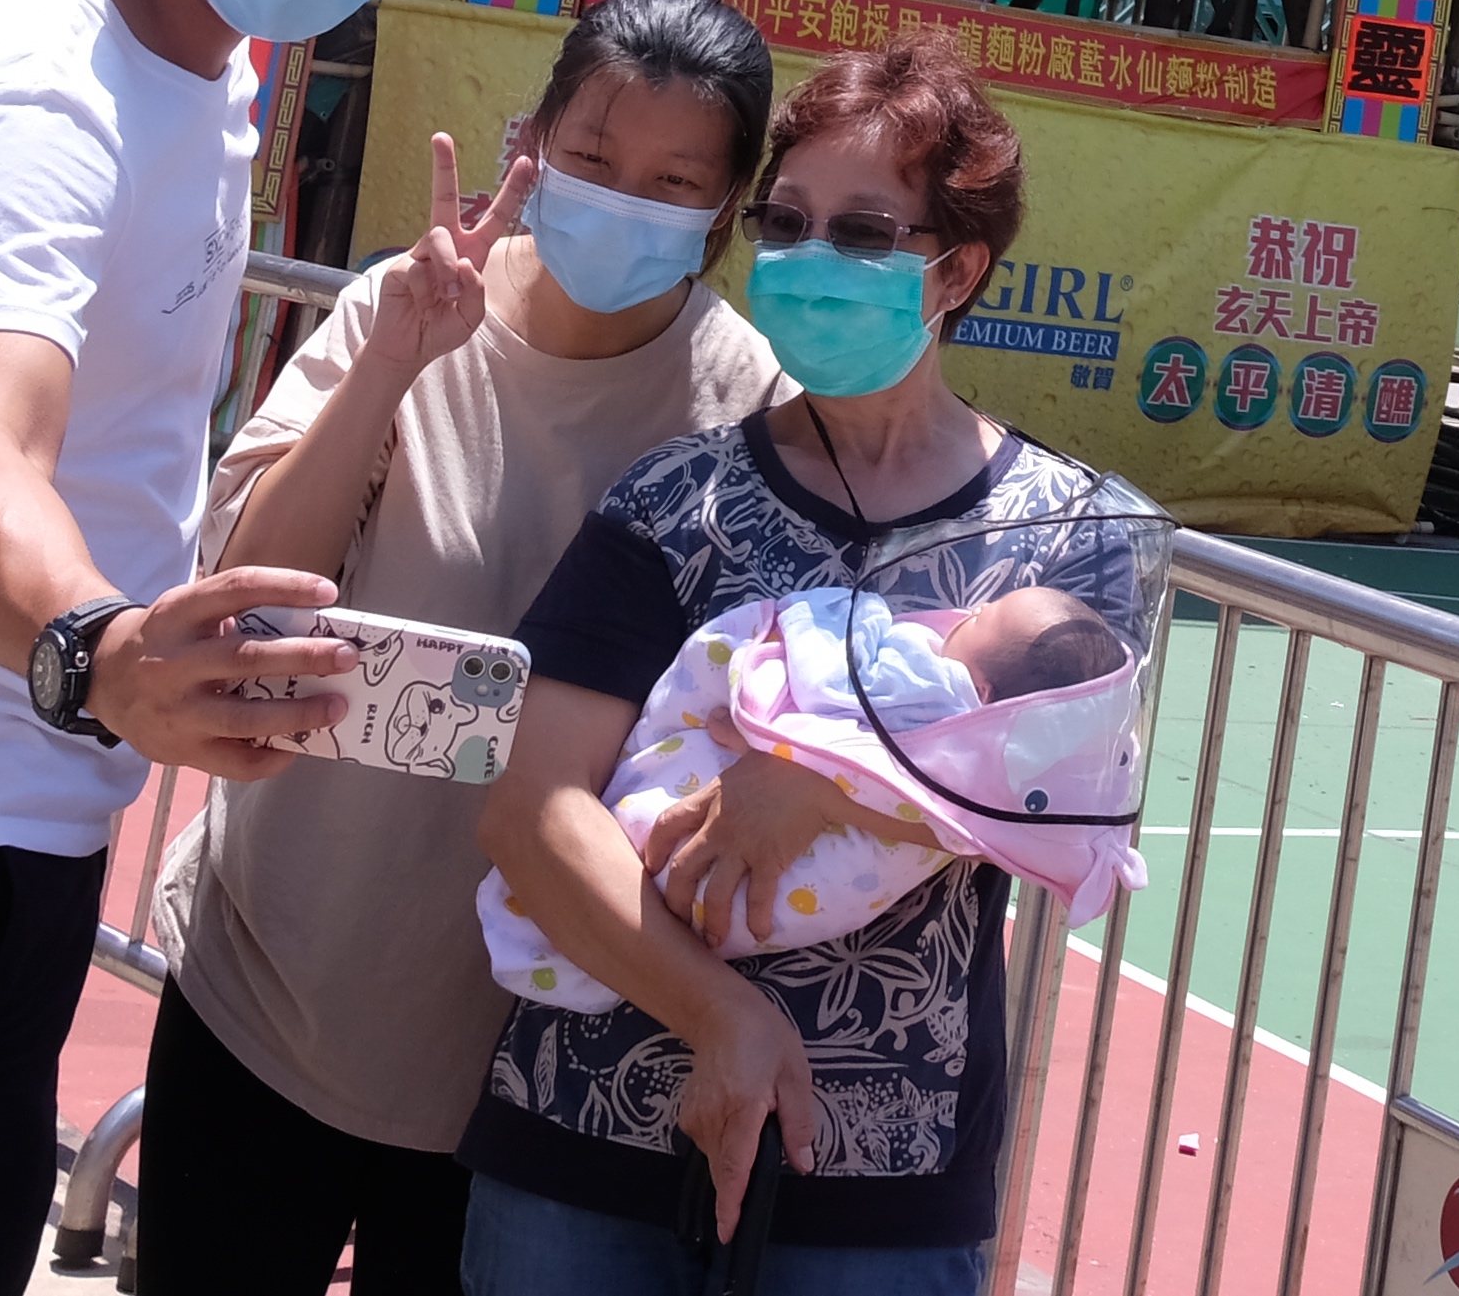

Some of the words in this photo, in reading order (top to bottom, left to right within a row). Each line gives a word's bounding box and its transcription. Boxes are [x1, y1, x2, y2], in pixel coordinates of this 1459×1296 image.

[1245, 214, 1359, 291] 恭祝
[1213, 283, 1380, 348] 玄天上帝
[954, 318, 1046, 352] EMIUM
[1049, 327, 1114, 359] BEER
[1069, 363, 1116, 392] 敬賀
[1148, 352, 1419, 429] 太平清醮
[415, 636, 465, 655] HAPPY
[360, 703, 379, 745] RICH
[483, 735, 500, 780] CUTE
